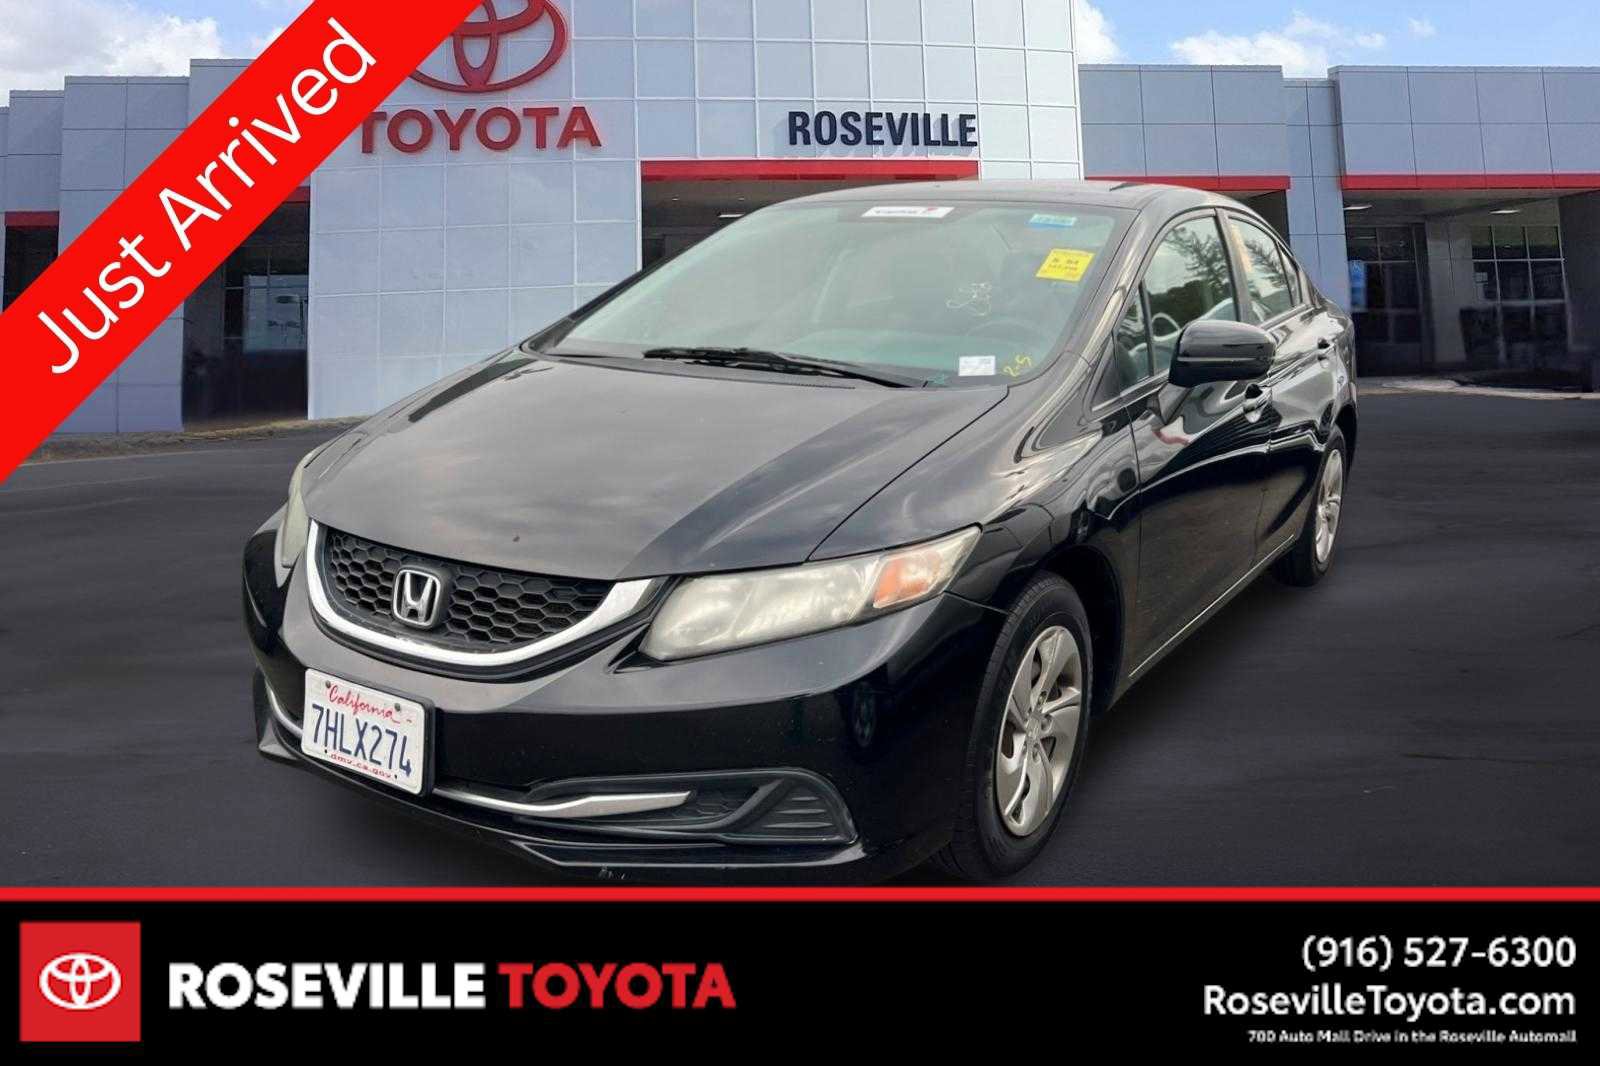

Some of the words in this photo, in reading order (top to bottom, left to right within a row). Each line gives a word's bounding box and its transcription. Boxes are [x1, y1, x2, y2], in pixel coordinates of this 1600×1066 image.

[361, 106, 602, 154] TOYOTA
[788, 110, 978, 147] ROSEVILLE
[328, 684, 401, 724] California
[312, 703, 412, 777] 7HLX274
